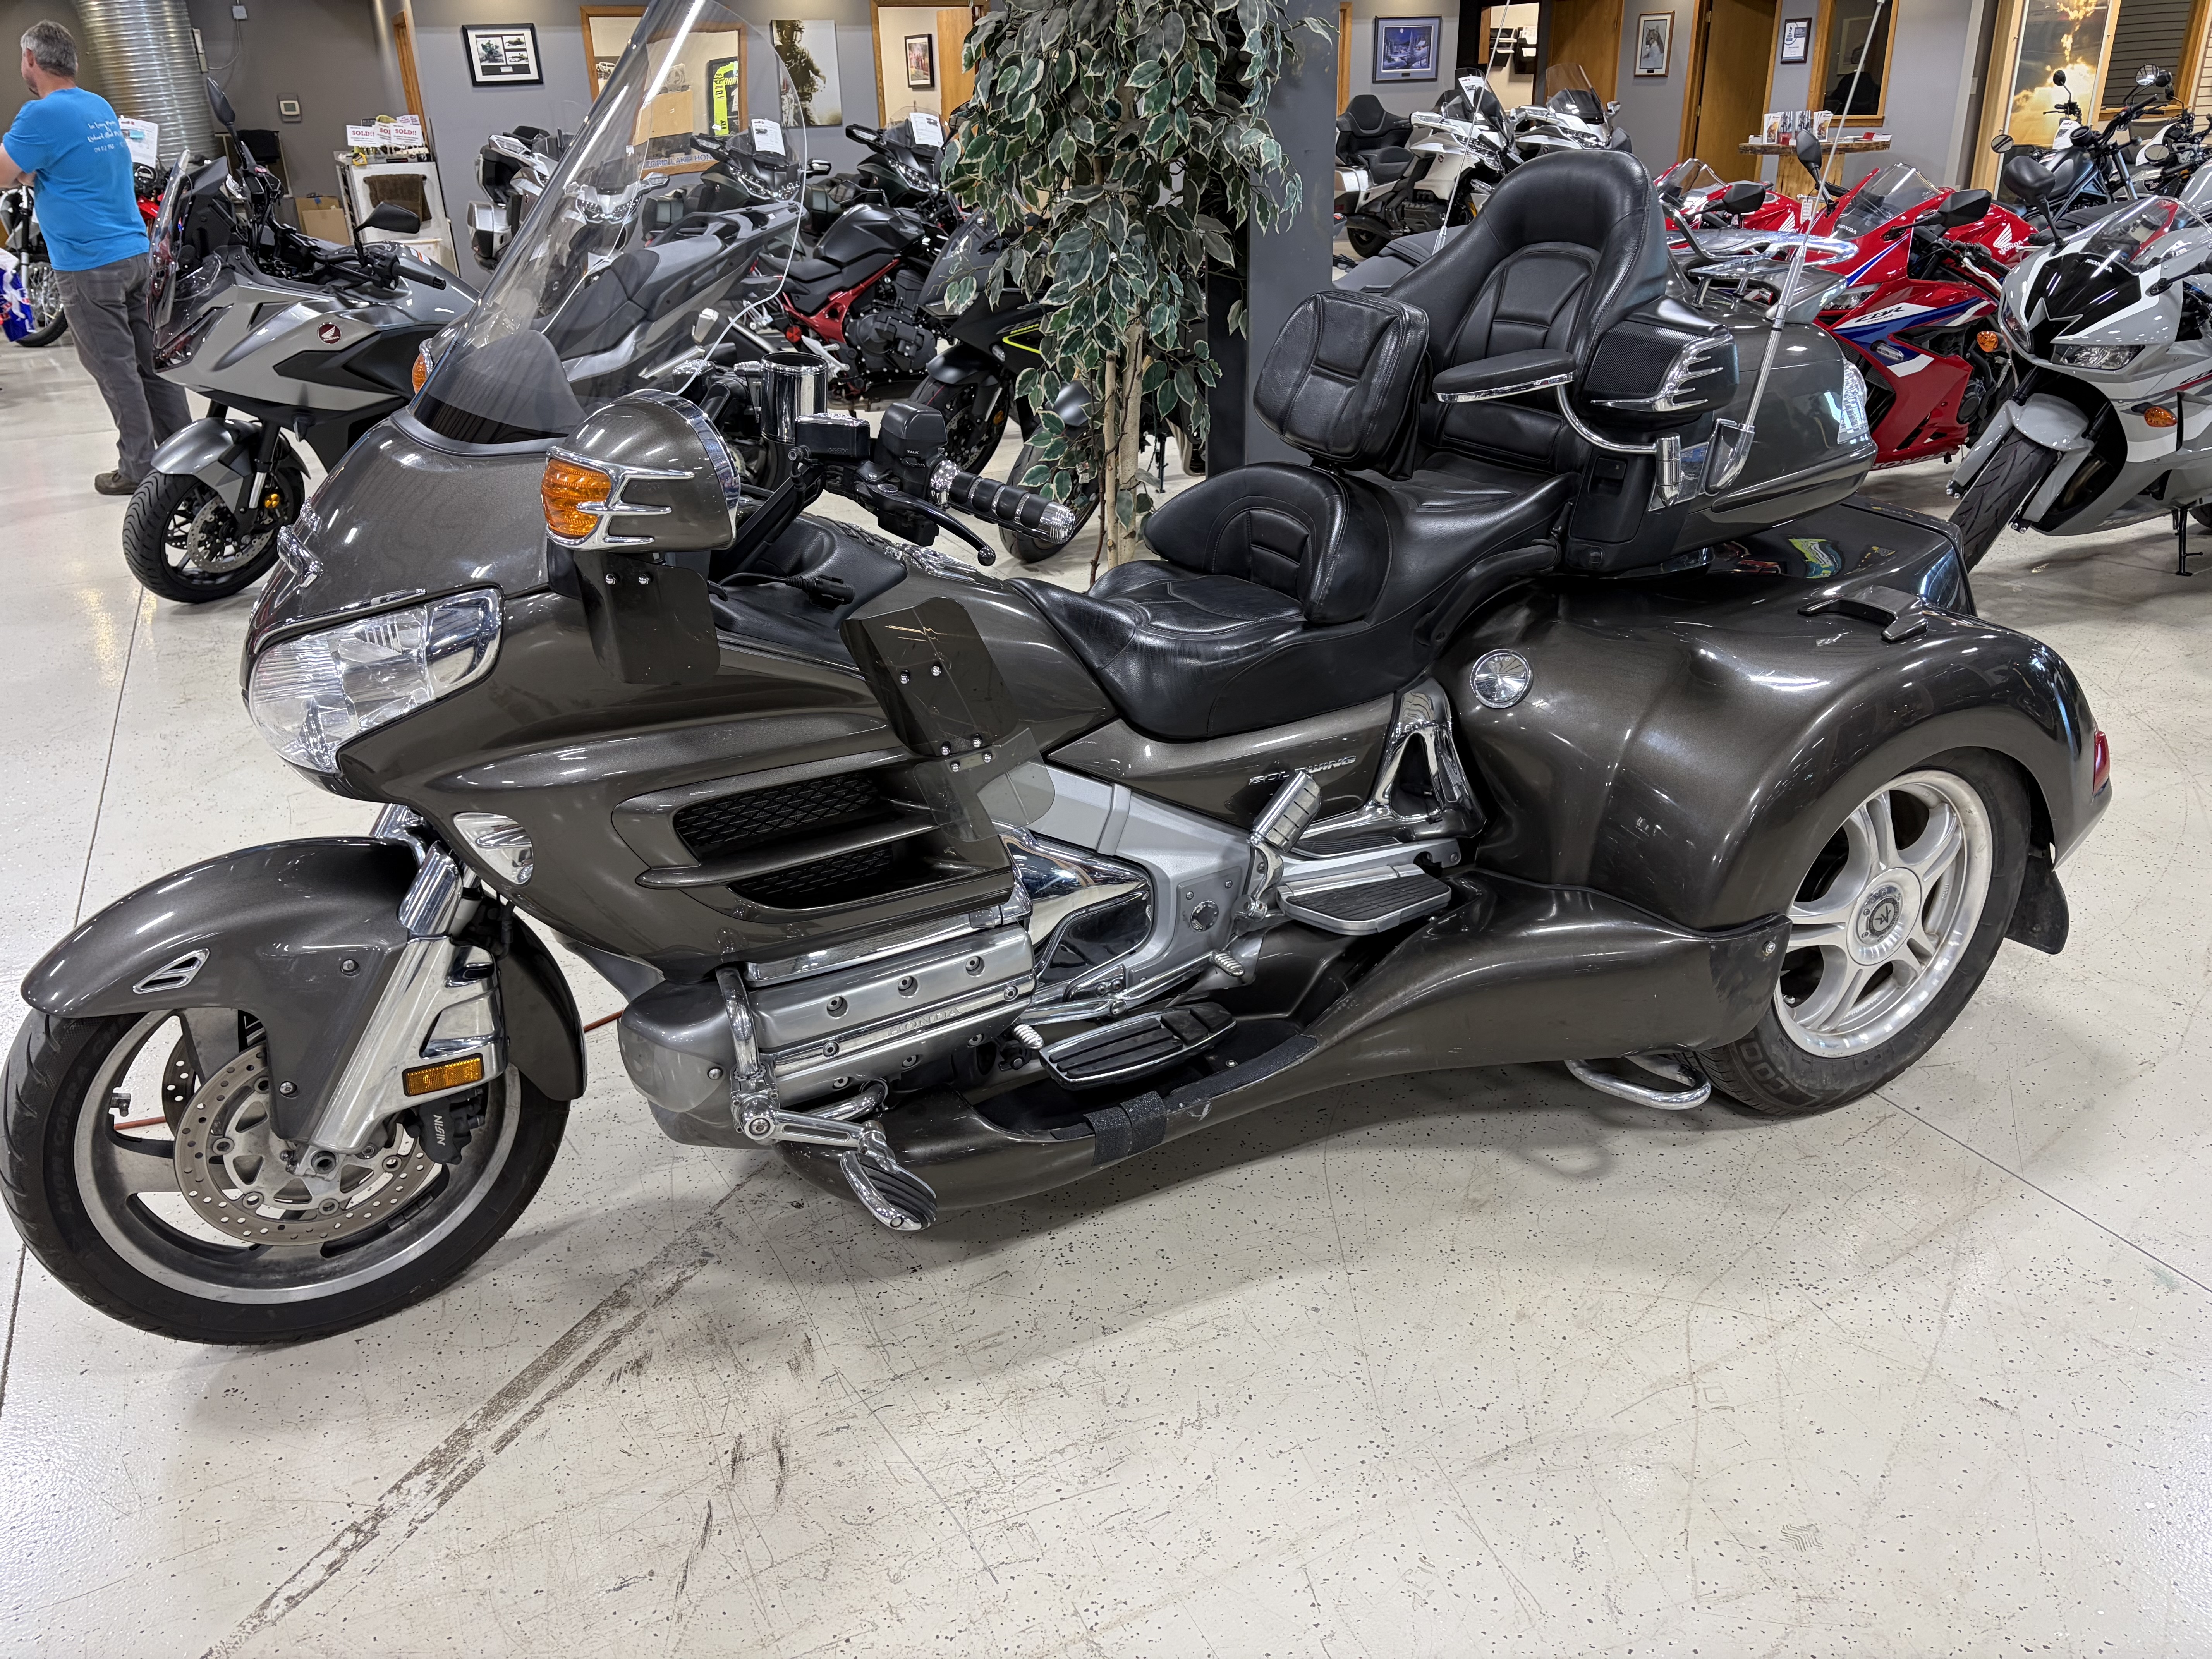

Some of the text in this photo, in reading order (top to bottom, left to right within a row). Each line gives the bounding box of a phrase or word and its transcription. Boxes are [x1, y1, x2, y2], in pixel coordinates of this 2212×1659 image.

[1837, 224, 1857, 235] HONDA
[1998, 240, 2023, 255] HONDA
[1855, 306, 1905, 323] CBR
[886, 1007, 962, 1036] HONDA
[433, 1114, 446, 1146] NISSIN
